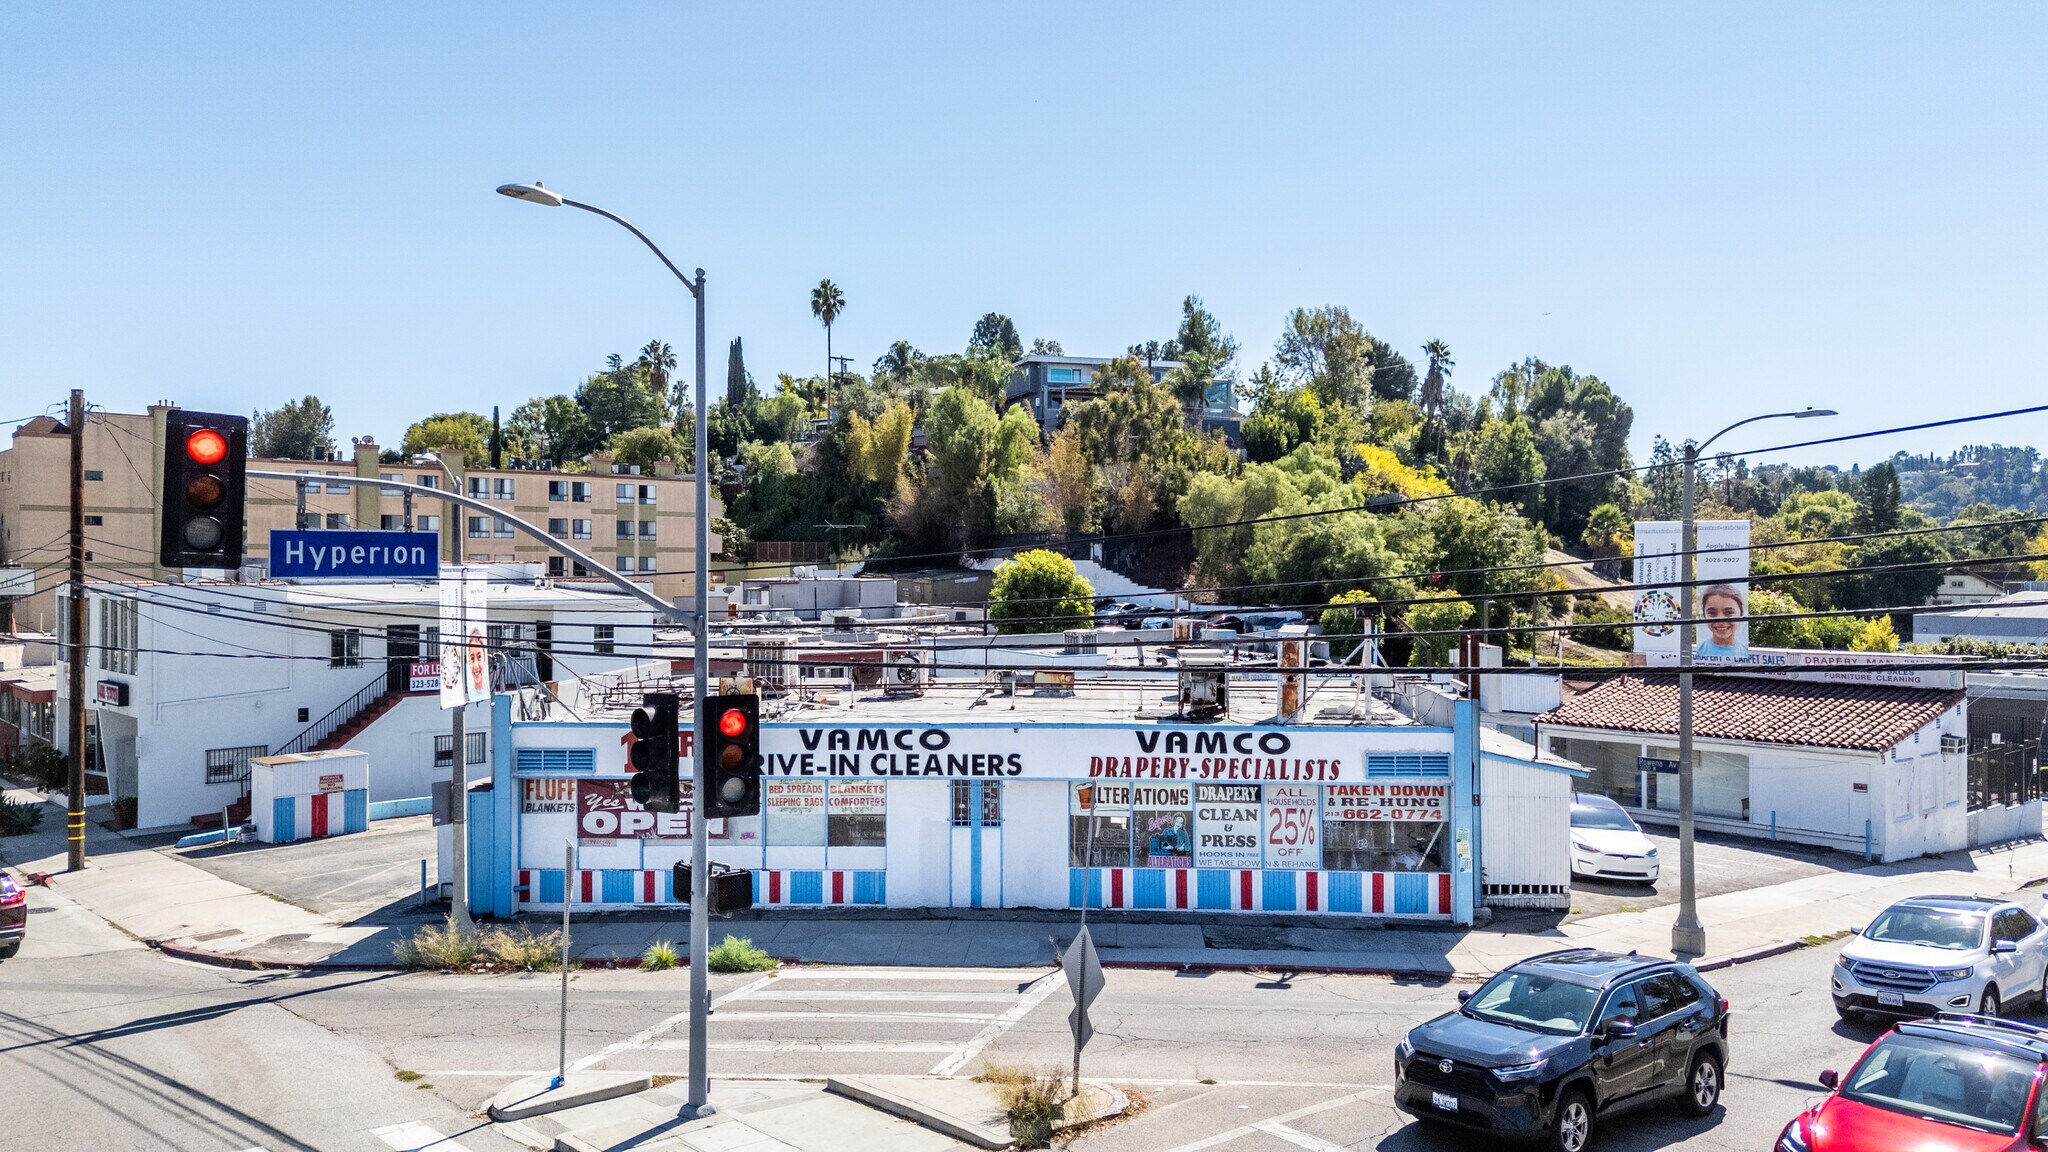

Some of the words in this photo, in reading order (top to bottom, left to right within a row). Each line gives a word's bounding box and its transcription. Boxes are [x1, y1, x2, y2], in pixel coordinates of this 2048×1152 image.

[285, 540, 426, 571] Hyperion
[1762, 654, 1786, 665] SALES
[1804, 656, 1858, 664] DRAPERY
[412, 664, 430, 676] FOR
[1824, 672, 1872, 681] FURNITURE
[1875, 674, 1921, 683] CLEANING
[411, 679, 441, 689] 323-528-
[798, 728, 951, 751] VAMCO
[1135, 730, 1292, 755] VAMCO
[759, 753, 860, 776] IVE-IN
[870, 753, 1022, 776] CLEANERS
[1088, 756, 1342, 781] DRAPERY-SPECIALISTS
[525, 779, 576, 801] FLUFF
[768, 784, 784, 794] BED
[786, 784, 823, 794] SPREADS
[830, 784, 885, 794] BLANKETS
[1198, 786, 1259, 801] DRAPERY
[1276, 788, 1308, 797] ALL
[1326, 785, 1385, 797] TAKEN
[1390, 785, 1444, 797] DOWN
[1087, 786, 1189, 805] LTERATIONS
[525, 802, 576, 813] BLANKETS
[584, 793, 622, 811] Yes
[767, 797, 801, 807] SLEEPING
[804, 797, 824, 807] BAGS
[828, 797, 885, 807] COMFORTERS
[1267, 798, 1317, 806] HOUSEHOLDS
[1328, 797, 1336, 806] &
[1341, 797, 1440, 807] RE-HUNG
[1198, 808, 1258, 821] CLEAN
[1223, 823, 1233, 832] &
[1269, 807, 1315, 846] 25%
[1200, 834, 1257, 848] PRESS
[1278, 848, 1304, 857] OFF
[1147, 855, 1192, 867] ALTERATIONS
[1198, 859, 1213, 867] WE
[1214, 860, 1236, 868] TAKE
[1283, 861, 1319, 869] REHANG
